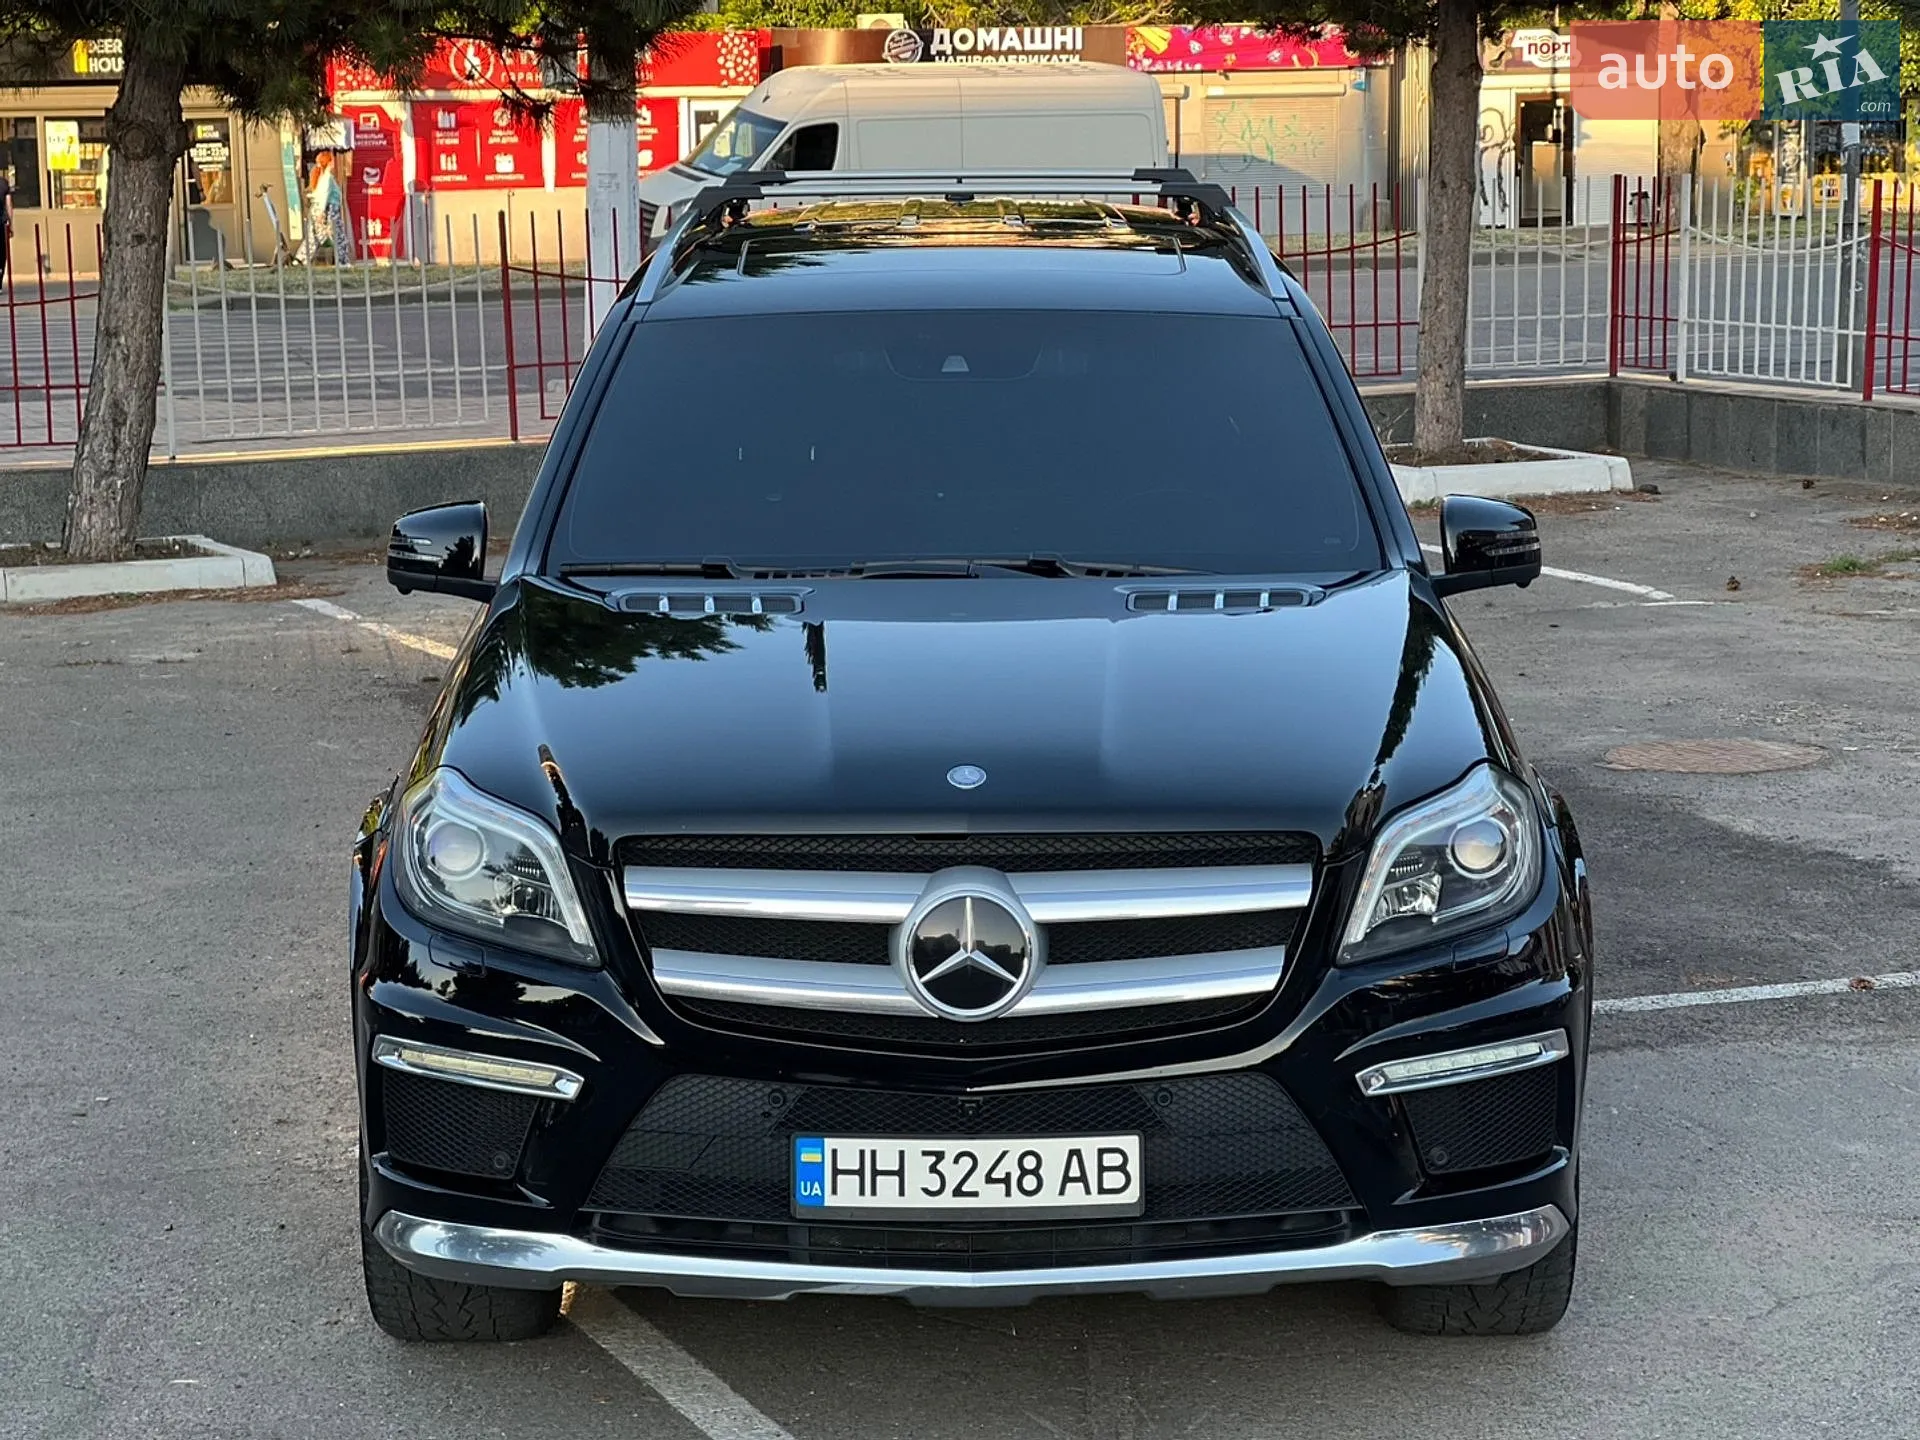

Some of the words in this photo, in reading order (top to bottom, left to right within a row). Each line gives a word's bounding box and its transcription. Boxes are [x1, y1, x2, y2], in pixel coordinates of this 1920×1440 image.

[930, 26, 1083, 55] ДОМАШНІ
[88, 56, 125, 73] HOU
[830, 1148, 905, 1197] HH
[920, 1149, 1044, 1198] 3248
[1057, 1146, 1132, 1196] AB
[800, 1181, 822, 1197] UA
